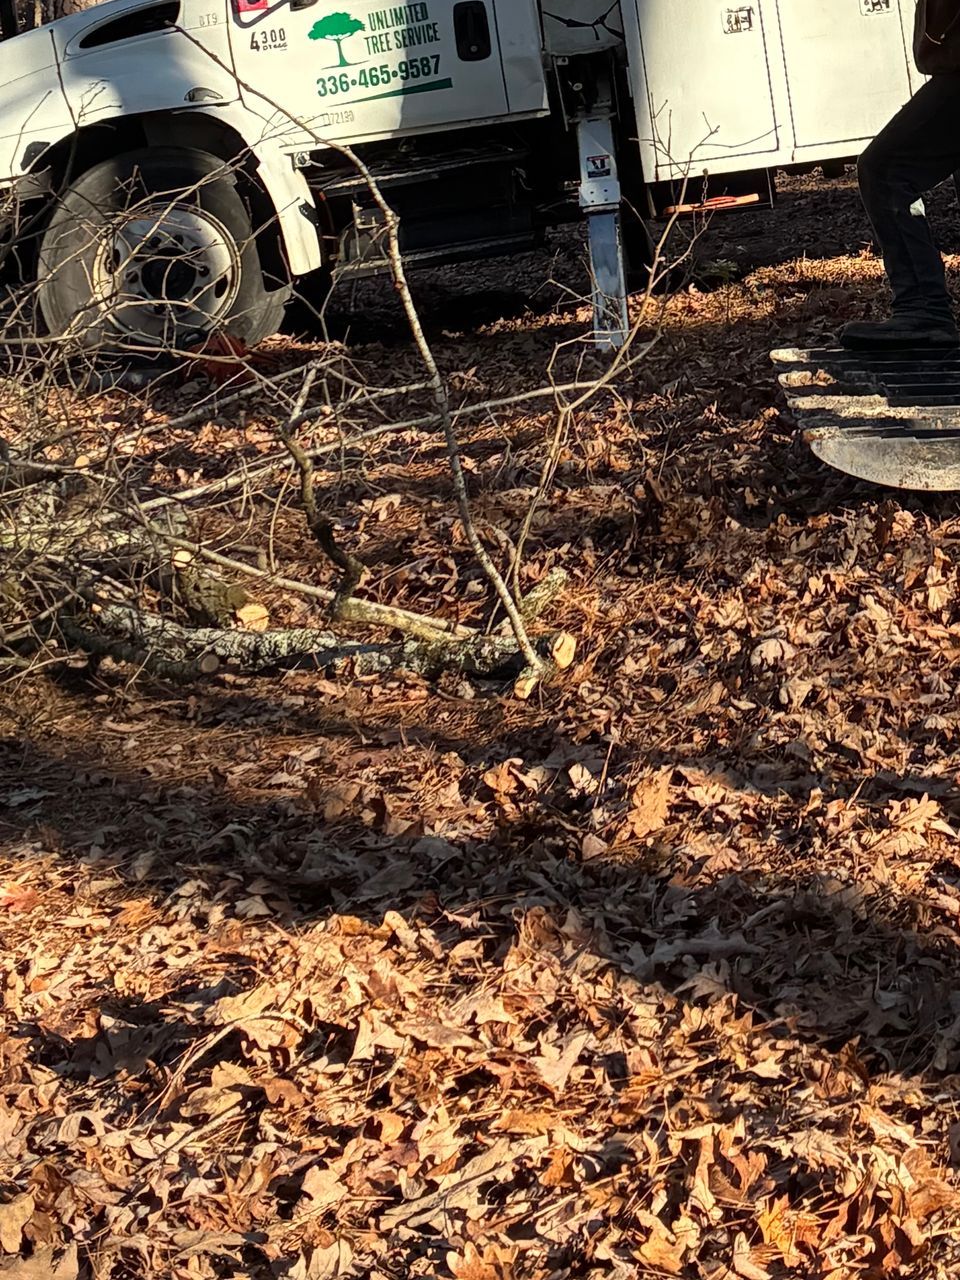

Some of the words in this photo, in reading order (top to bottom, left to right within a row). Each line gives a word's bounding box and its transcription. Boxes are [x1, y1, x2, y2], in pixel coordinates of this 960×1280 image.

[367, 1, 429, 32] UNLIMITED
[250, 27, 287, 52] 4300
[363, 32, 393, 56] TREE
[393, 22, 441, 50] SERVICE
